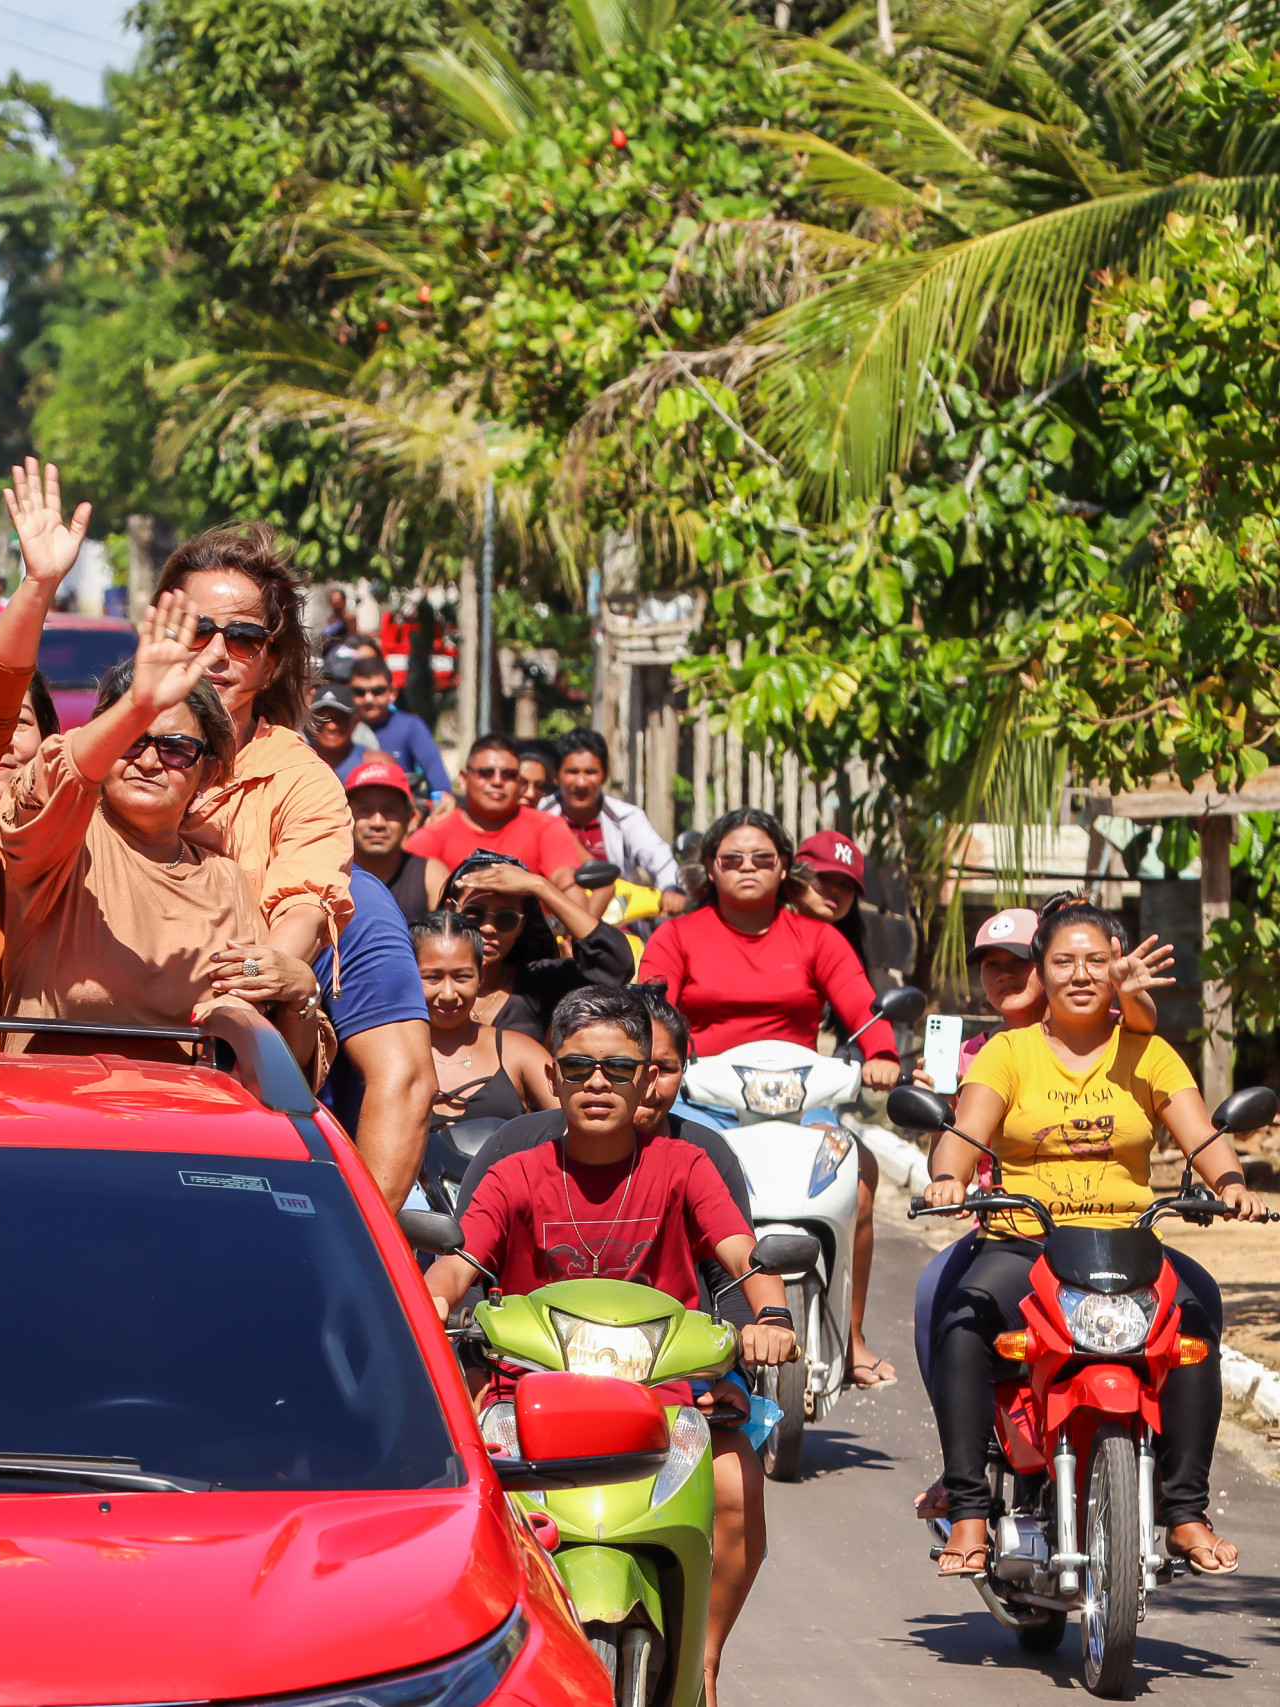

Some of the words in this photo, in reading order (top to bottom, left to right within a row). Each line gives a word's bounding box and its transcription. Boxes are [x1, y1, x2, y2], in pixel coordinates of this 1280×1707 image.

[278, 1197, 309, 1210] FIAT
[1040, 1199, 1115, 1217] OMIDA
[1089, 1271, 1128, 1281] HONDA
